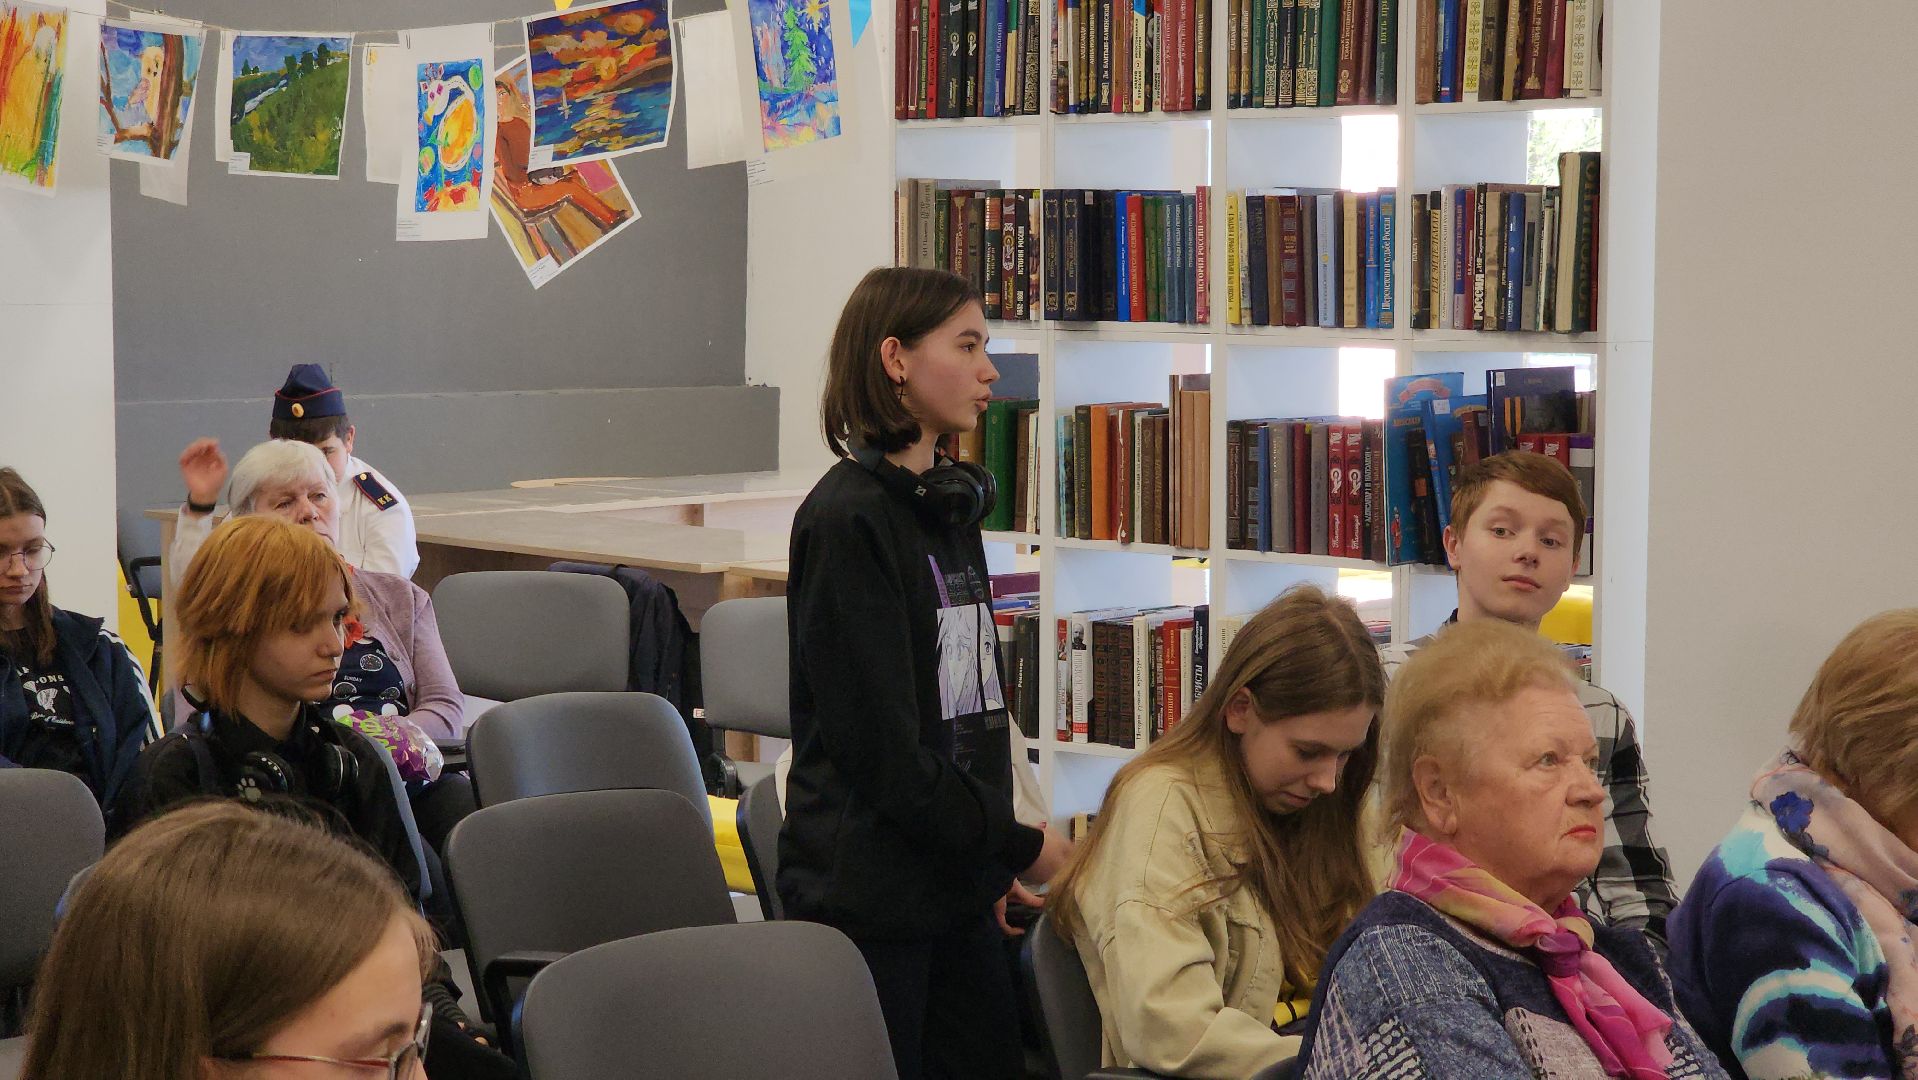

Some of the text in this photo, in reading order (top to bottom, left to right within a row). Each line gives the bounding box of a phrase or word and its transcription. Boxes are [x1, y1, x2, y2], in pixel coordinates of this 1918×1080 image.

[1017, 225, 1025, 248] РОССИИ
[1197, 225, 1205, 256] РОССИИ
[1382, 212, 1391, 237] России
[1431, 211, 1439, 273] ЭЙДЕЛЬМАН
[1197, 257, 1205, 292] ИСТОРИЯ
[1382, 268, 1393, 310] Шереметевы
[1474, 273, 1485, 321] РОССИЯ
[1135, 657, 1143, 687] культуры
